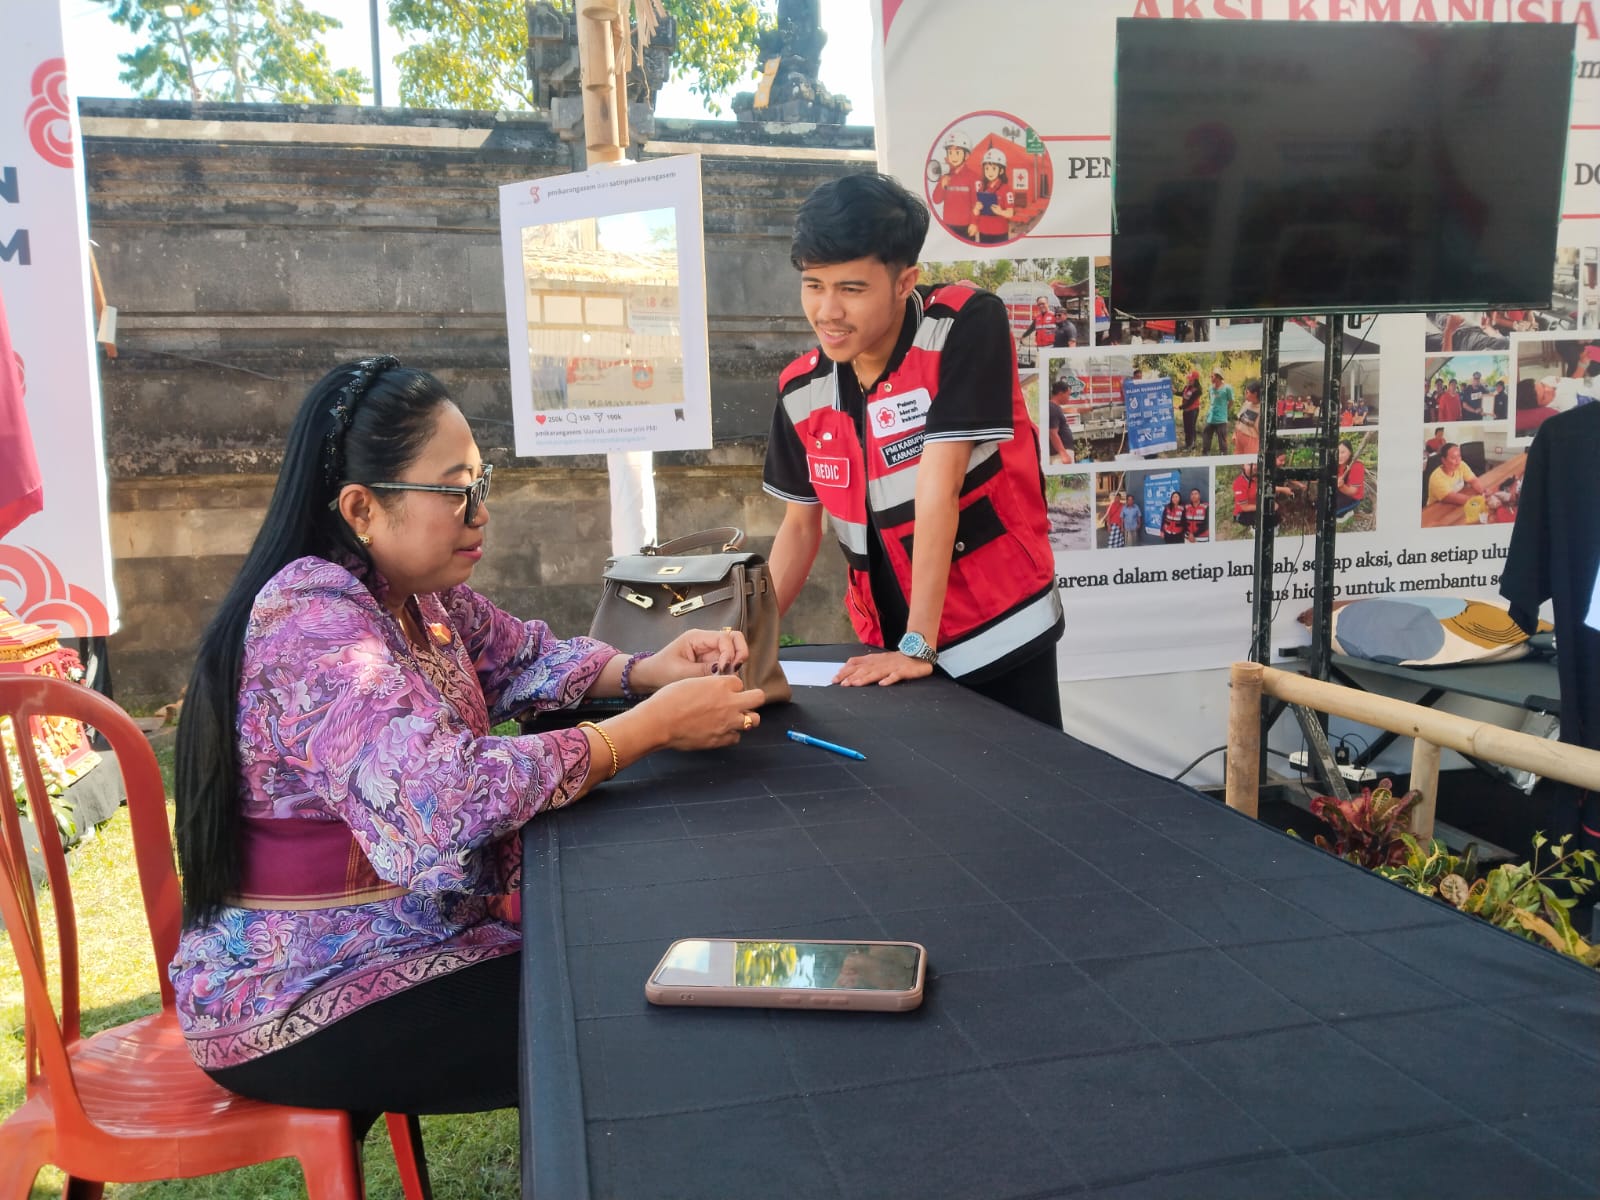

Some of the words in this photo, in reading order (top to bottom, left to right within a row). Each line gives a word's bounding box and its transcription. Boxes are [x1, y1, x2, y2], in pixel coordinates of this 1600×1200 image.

[901, 411, 928, 423] Indonesi
[884, 444, 899, 456] PMI
[814, 462, 839, 480] MEDIC
[1056, 573, 1109, 589] arena
[1113, 566, 1168, 585] dalam
[1171, 563, 1224, 583] setiap
[1228, 557, 1299, 578] lanah,
[1302, 556, 1352, 574] seap
[1355, 550, 1393, 569] aksi,
[1396, 549, 1428, 566] dan
[1430, 545, 1478, 566] setiap
[1481, 543, 1510, 560] ulu
[1345, 577, 1396, 596] untuk
[1399, 572, 1487, 593] membantu
